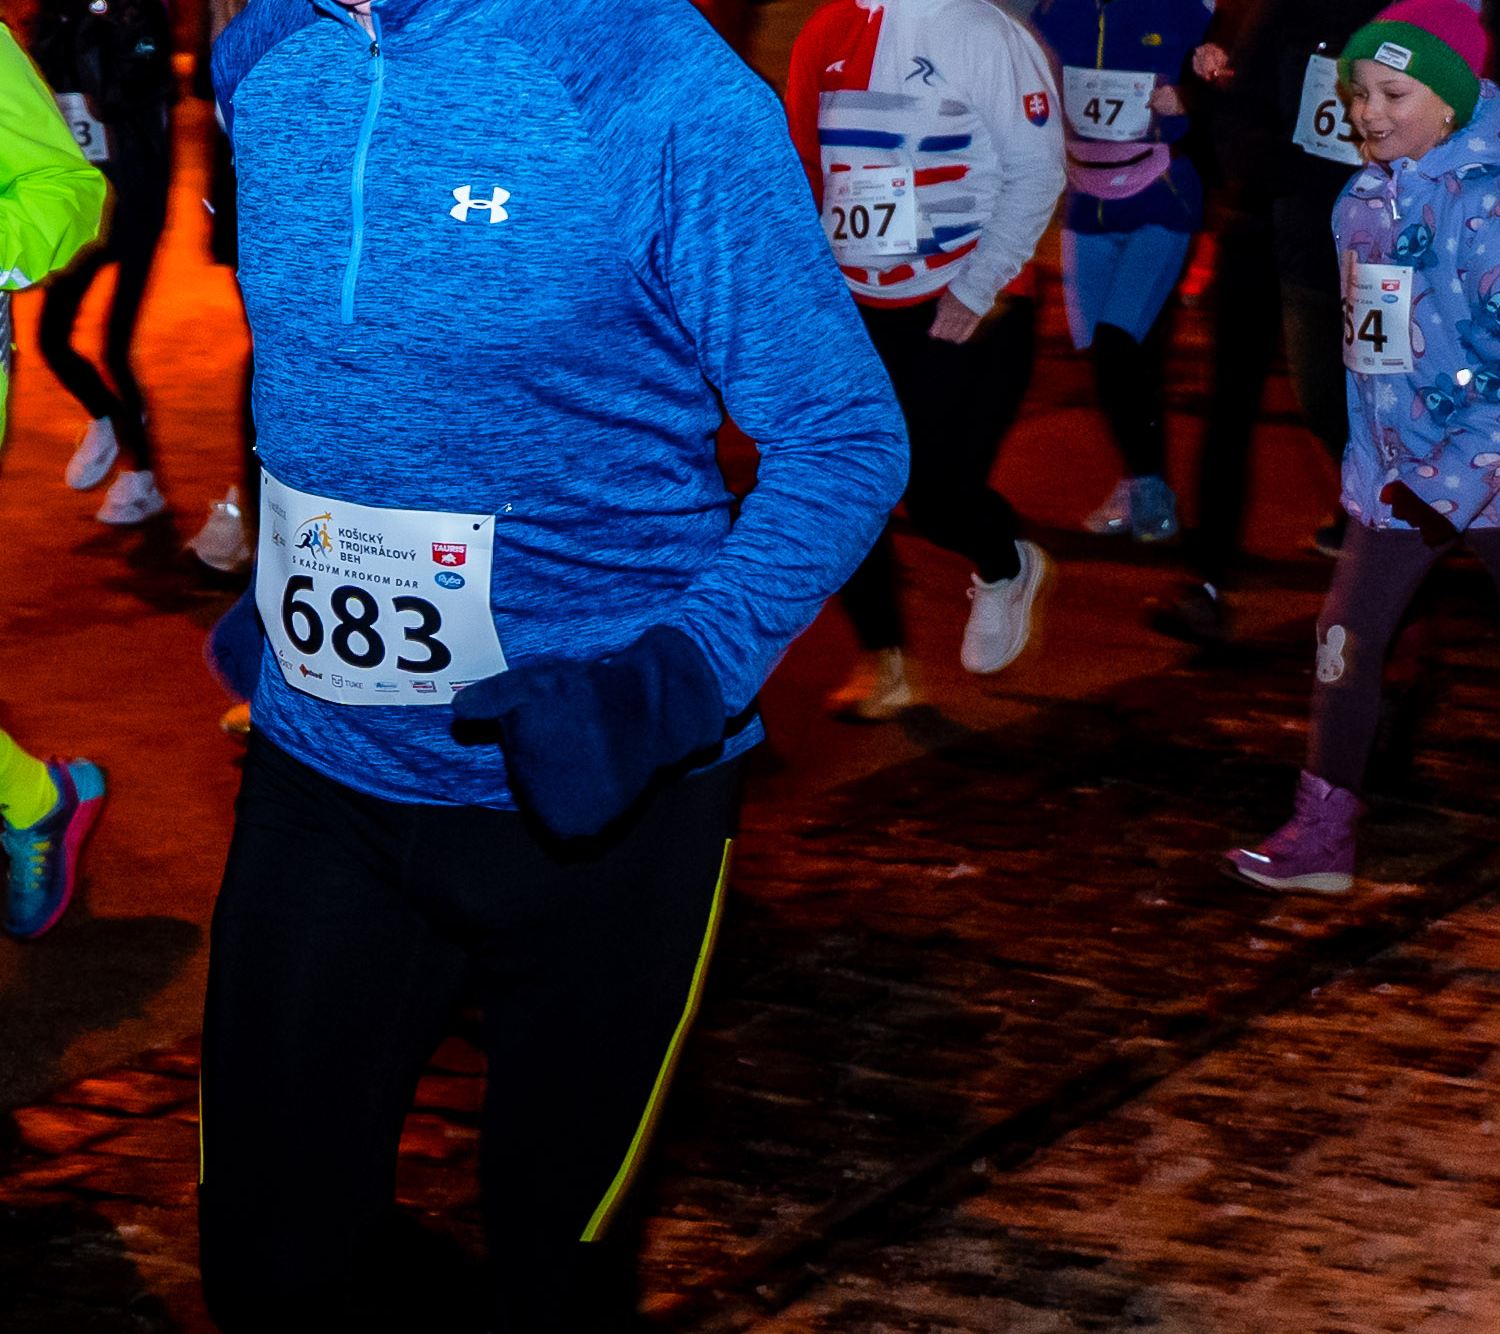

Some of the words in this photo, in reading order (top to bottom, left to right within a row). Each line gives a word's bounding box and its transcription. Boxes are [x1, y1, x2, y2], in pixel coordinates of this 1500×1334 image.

[1083, 97, 1125, 126] 47
[831, 202, 896, 240] 207
[338, 527, 384, 545] KOŠICKÝ
[299, 558, 340, 576] KAŽDÝM
[344, 569, 391, 585] KROKOM
[395, 578, 419, 589] DAR
[340, 552, 361, 565] BEH
[281, 574, 452, 674] 683
